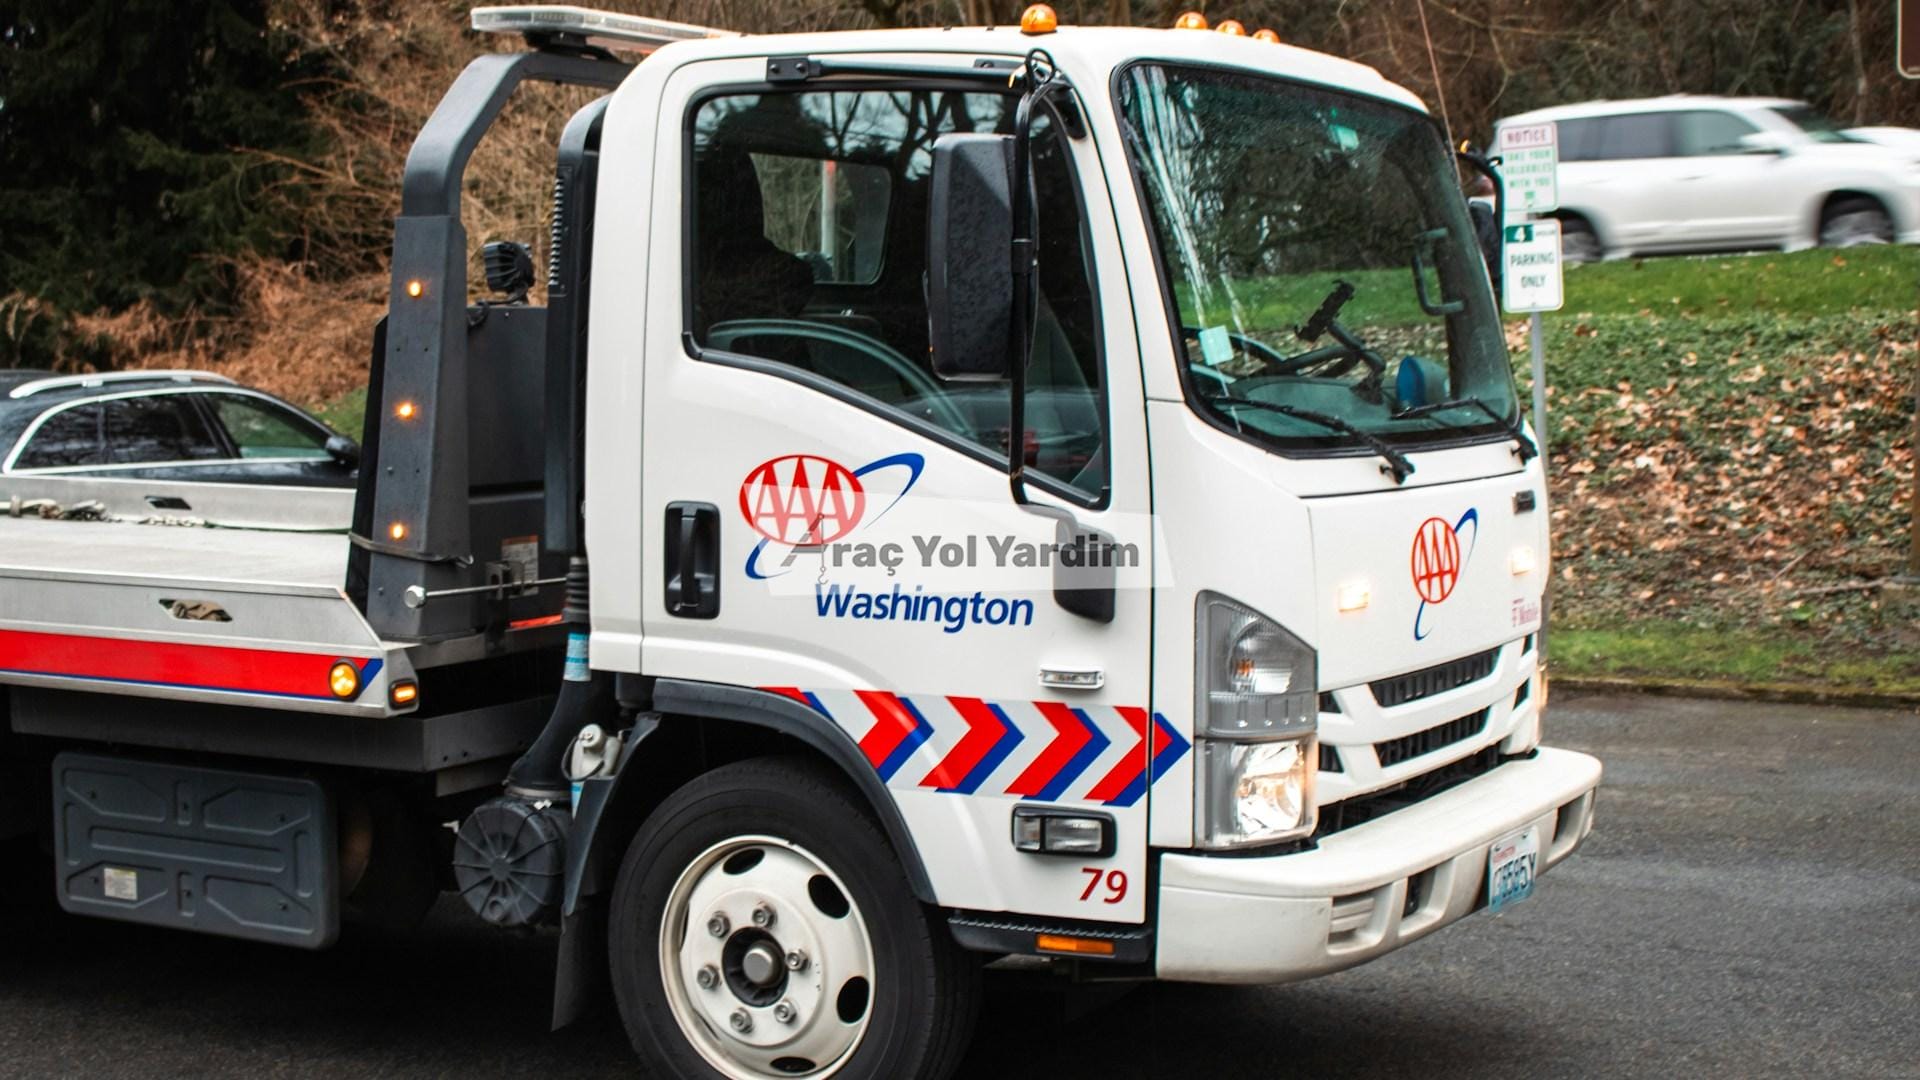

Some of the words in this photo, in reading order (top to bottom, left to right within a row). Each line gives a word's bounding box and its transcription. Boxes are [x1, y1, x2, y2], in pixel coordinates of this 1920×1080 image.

[1507, 129, 1547, 142] NOTICE
[1514, 226, 1525, 242] 4
[1510, 253, 1554, 266] PARKING
[1521, 274, 1546, 288] ONLY
[742, 456, 862, 544] AAA
[1413, 518, 1458, 602] AAA
[815, 583, 1034, 634] Washington
[1079, 867, 1129, 905] 79
